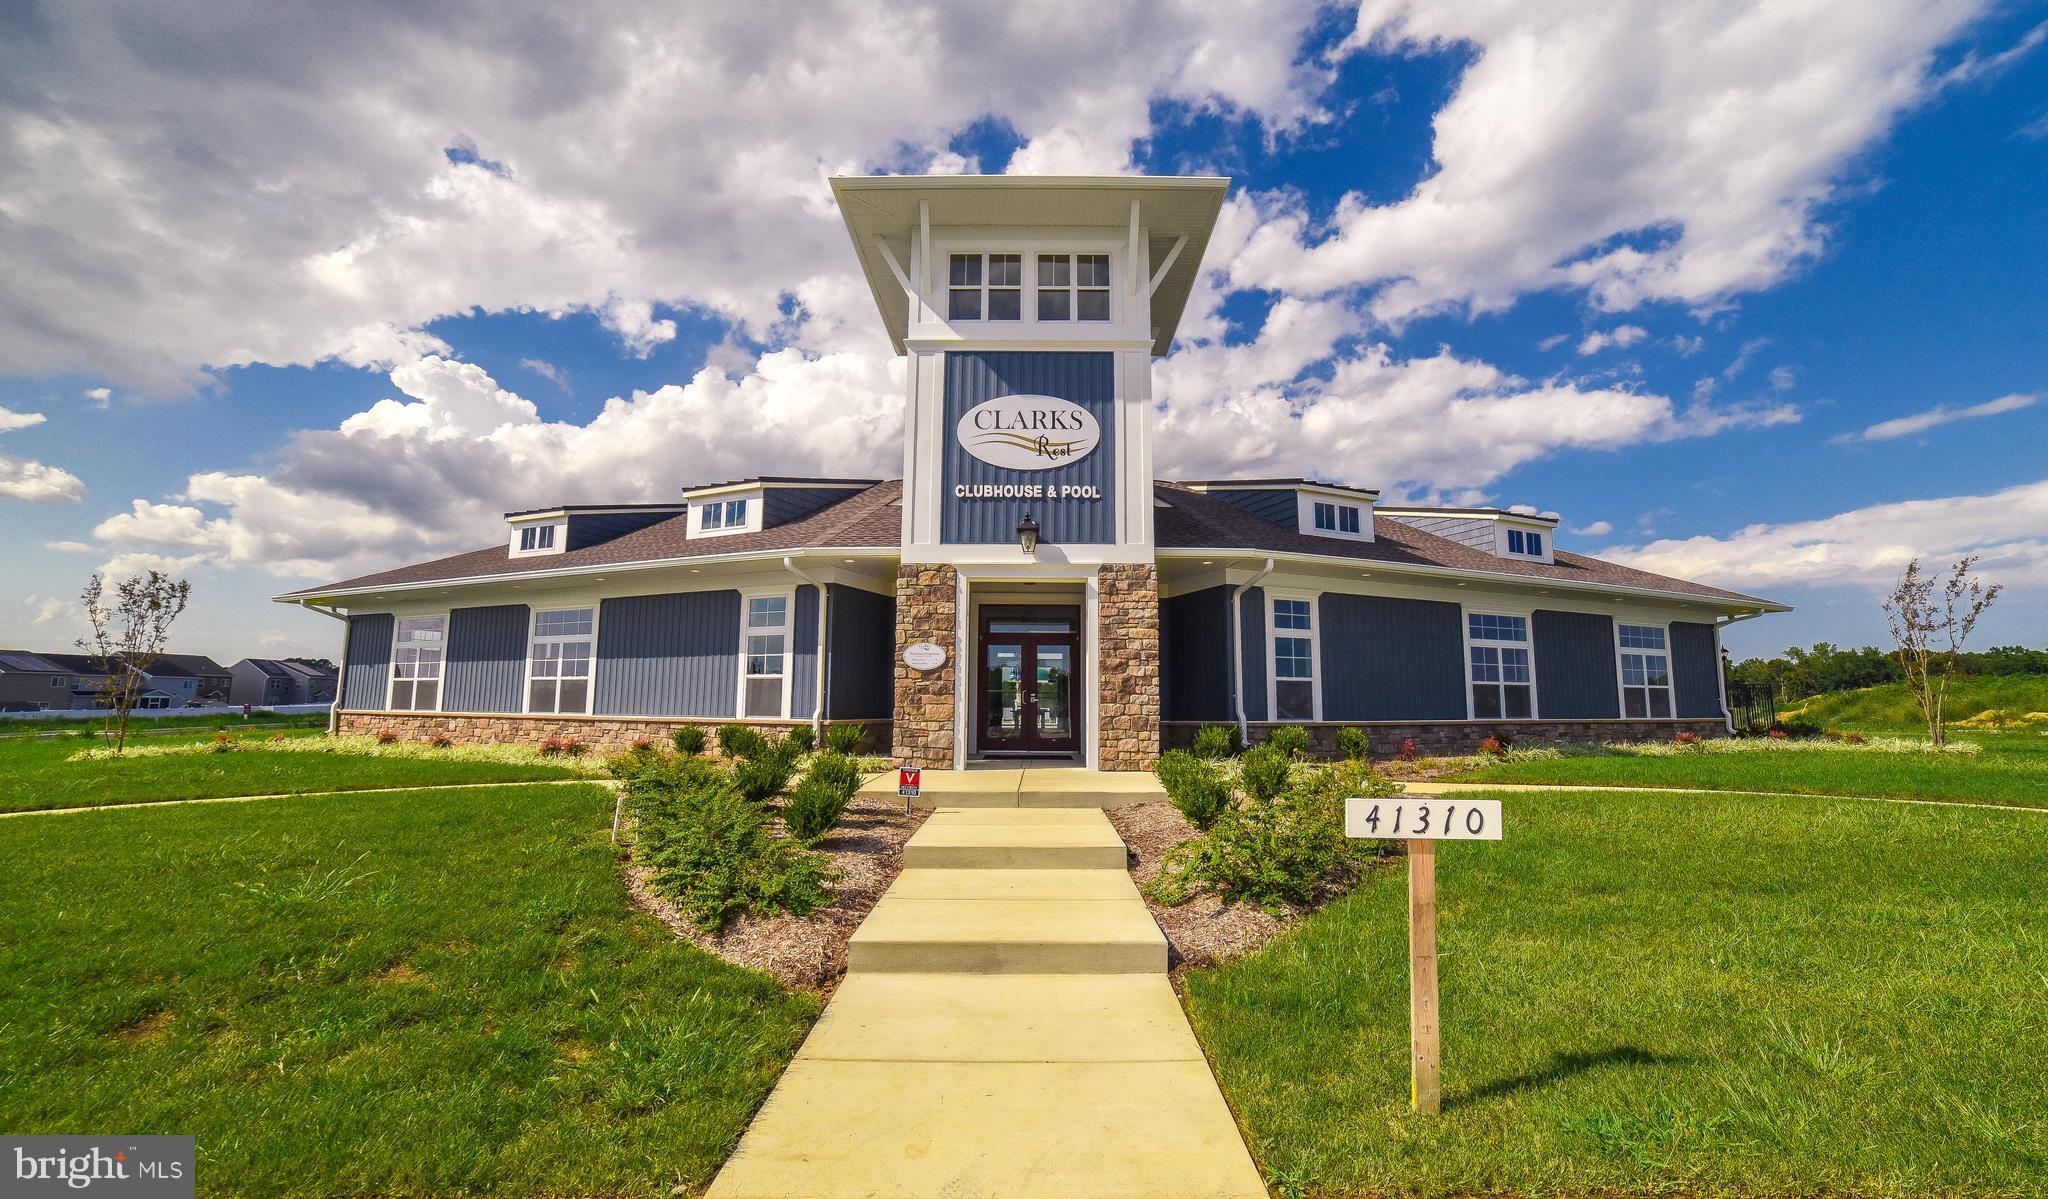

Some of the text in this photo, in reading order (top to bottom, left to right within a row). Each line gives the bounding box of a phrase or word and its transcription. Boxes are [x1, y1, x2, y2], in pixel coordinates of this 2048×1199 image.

[974, 410, 1083, 431] CLARKS
[1034, 434, 1072, 460] Rest
[955, 484, 1101, 499] CLUBHOUSE & POOL
[906, 772, 915, 783] V
[1365, 804, 1484, 836] 41310
